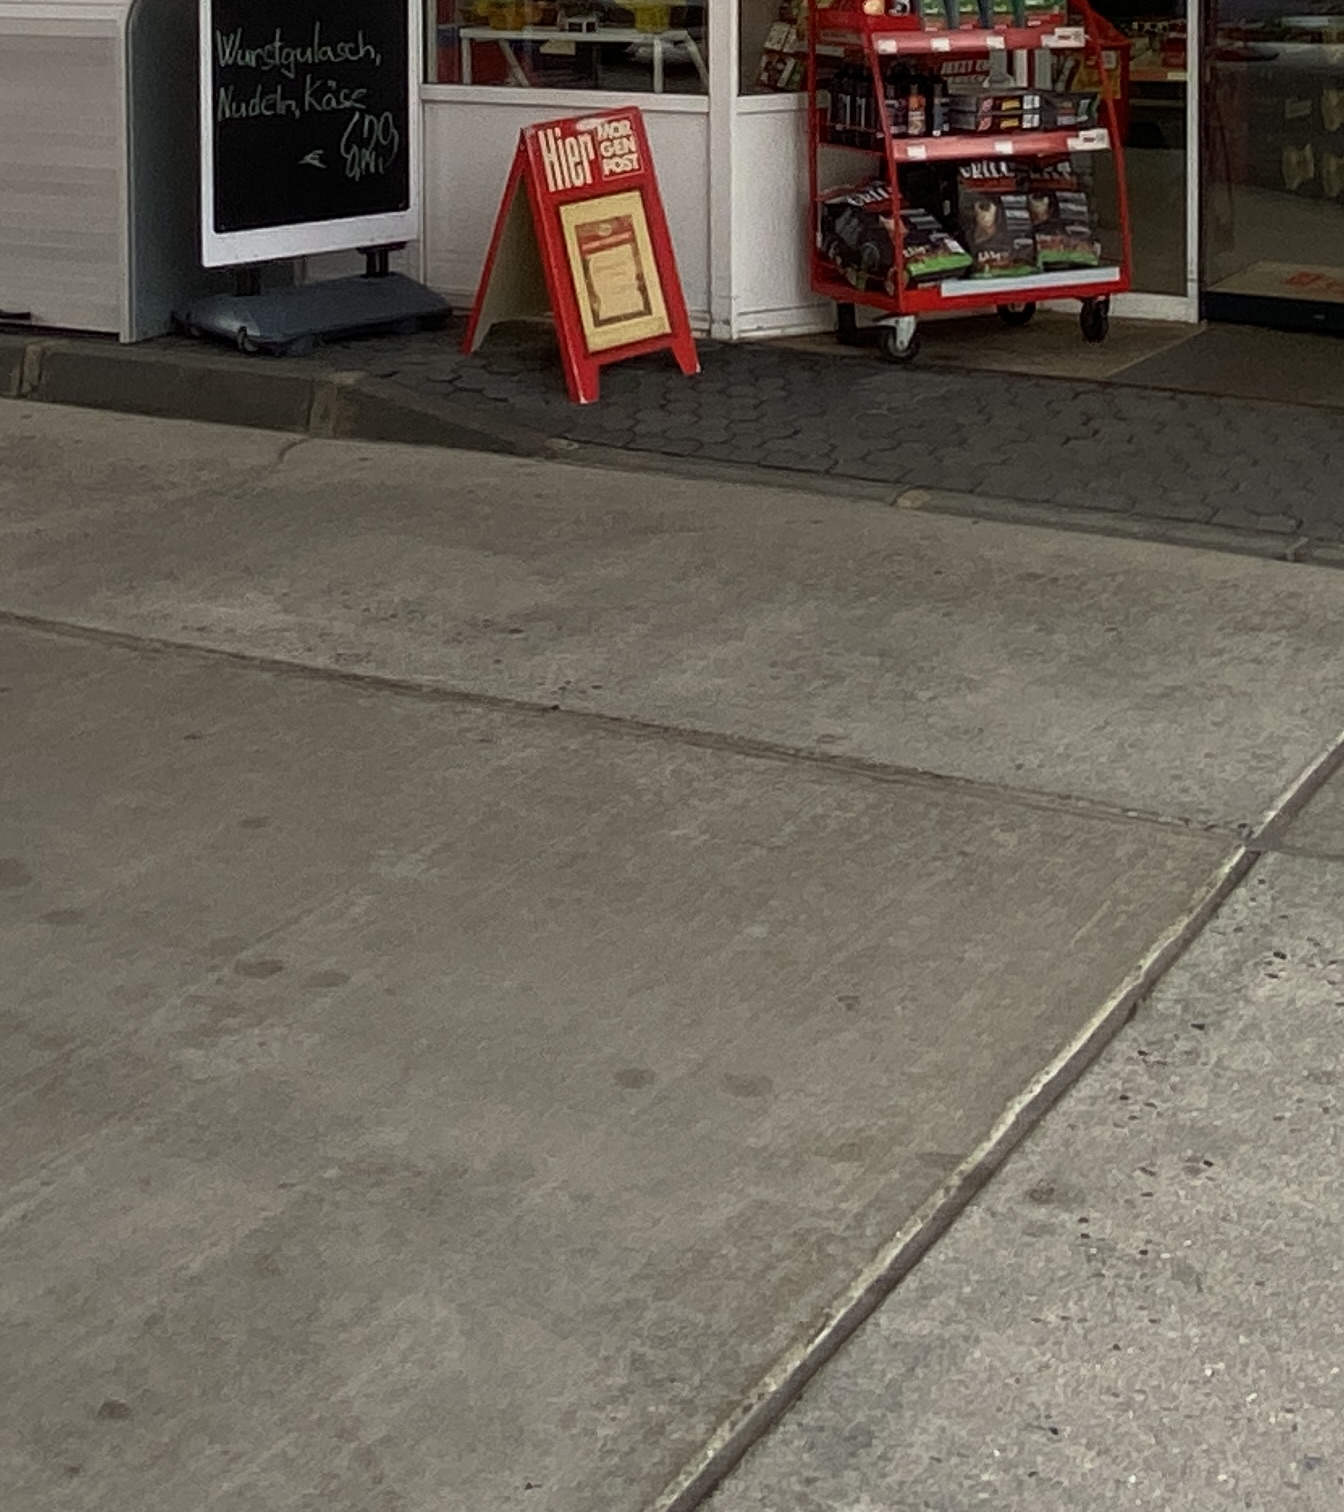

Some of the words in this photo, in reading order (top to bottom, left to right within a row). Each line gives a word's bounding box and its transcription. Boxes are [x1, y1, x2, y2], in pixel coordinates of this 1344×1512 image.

[600, 136, 636, 157] GEN
[538, 127, 595, 193] Hier
[602, 153, 639, 175] POST
